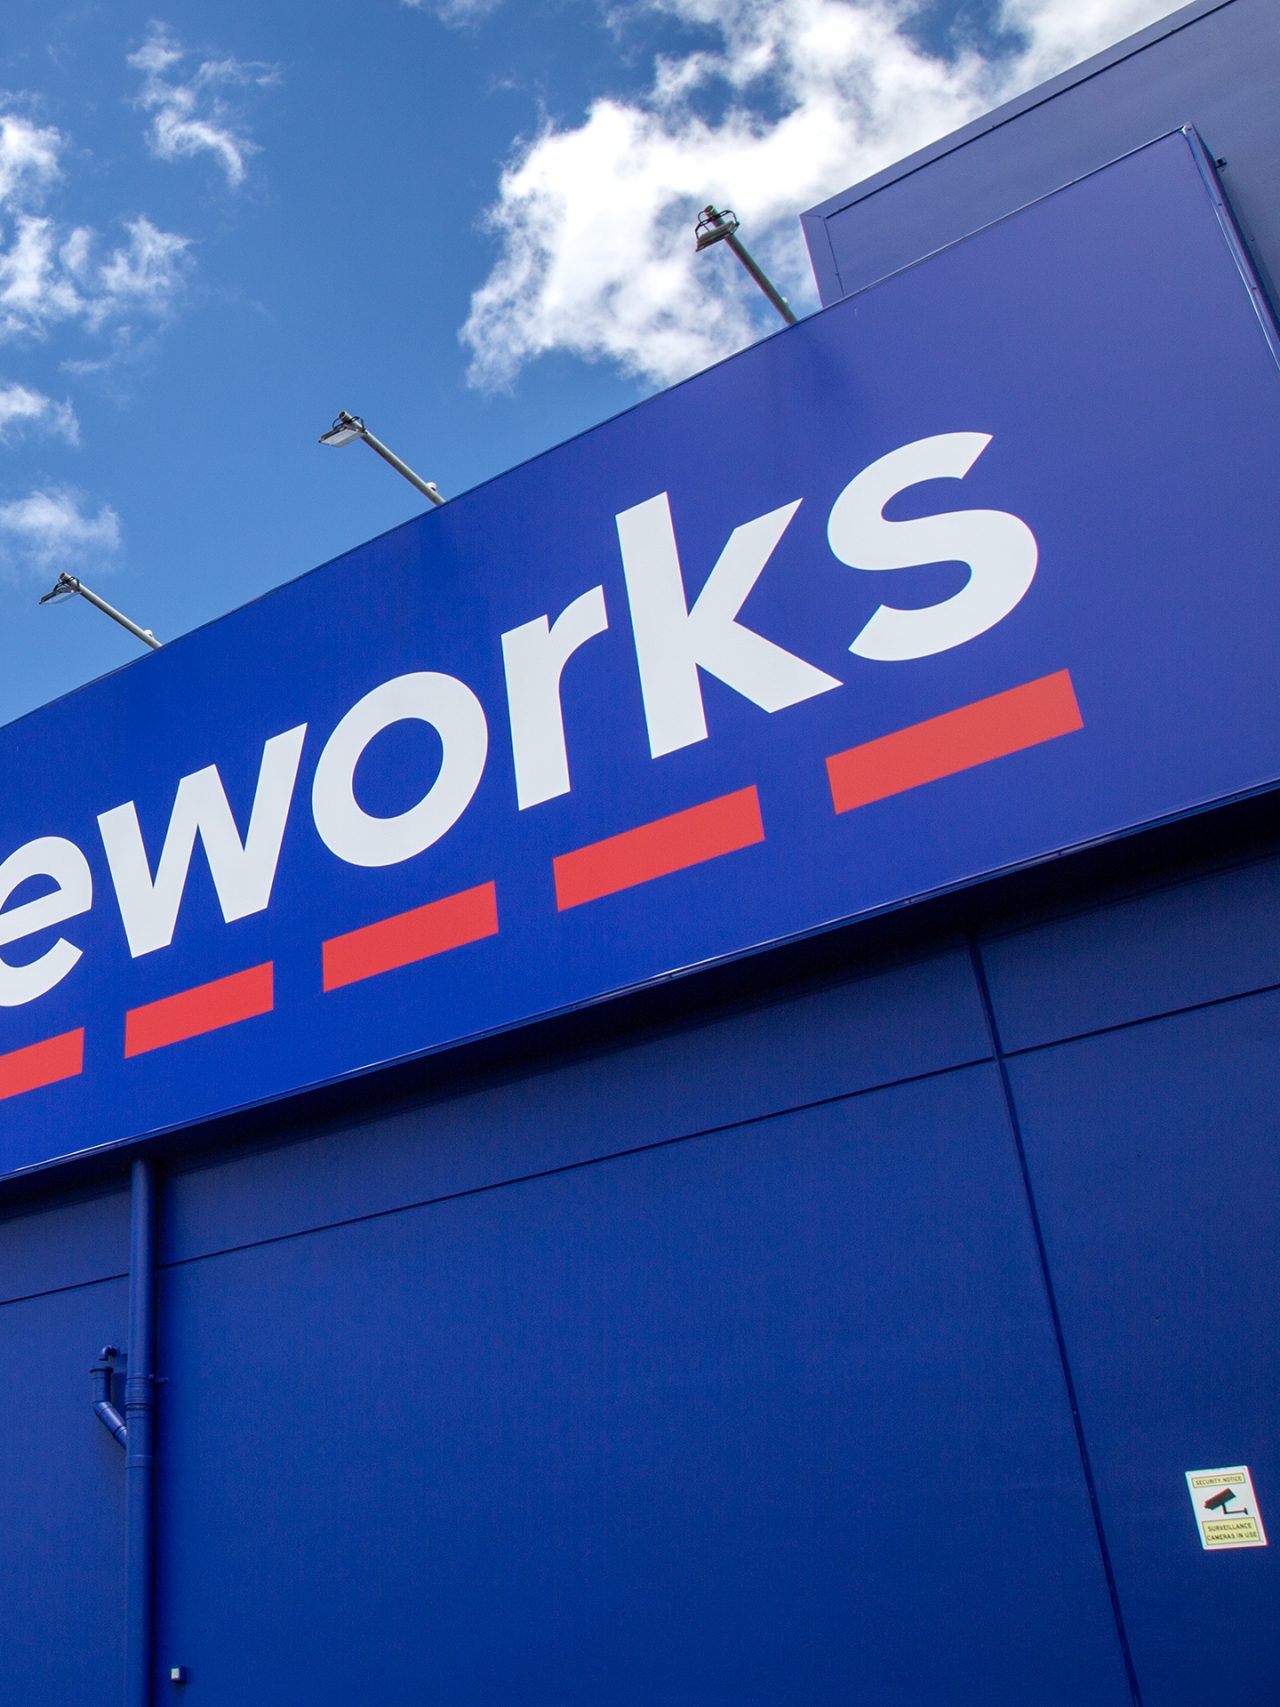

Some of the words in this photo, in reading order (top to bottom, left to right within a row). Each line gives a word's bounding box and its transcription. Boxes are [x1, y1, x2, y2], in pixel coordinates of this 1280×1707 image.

[1195, 1478, 1221, 1486] SECURITY
[1207, 1523, 1252, 1531] SURVEILLANCE
[1206, 1533, 1236, 1541] CAMERAS
[1245, 1531, 1258, 1539] USE
